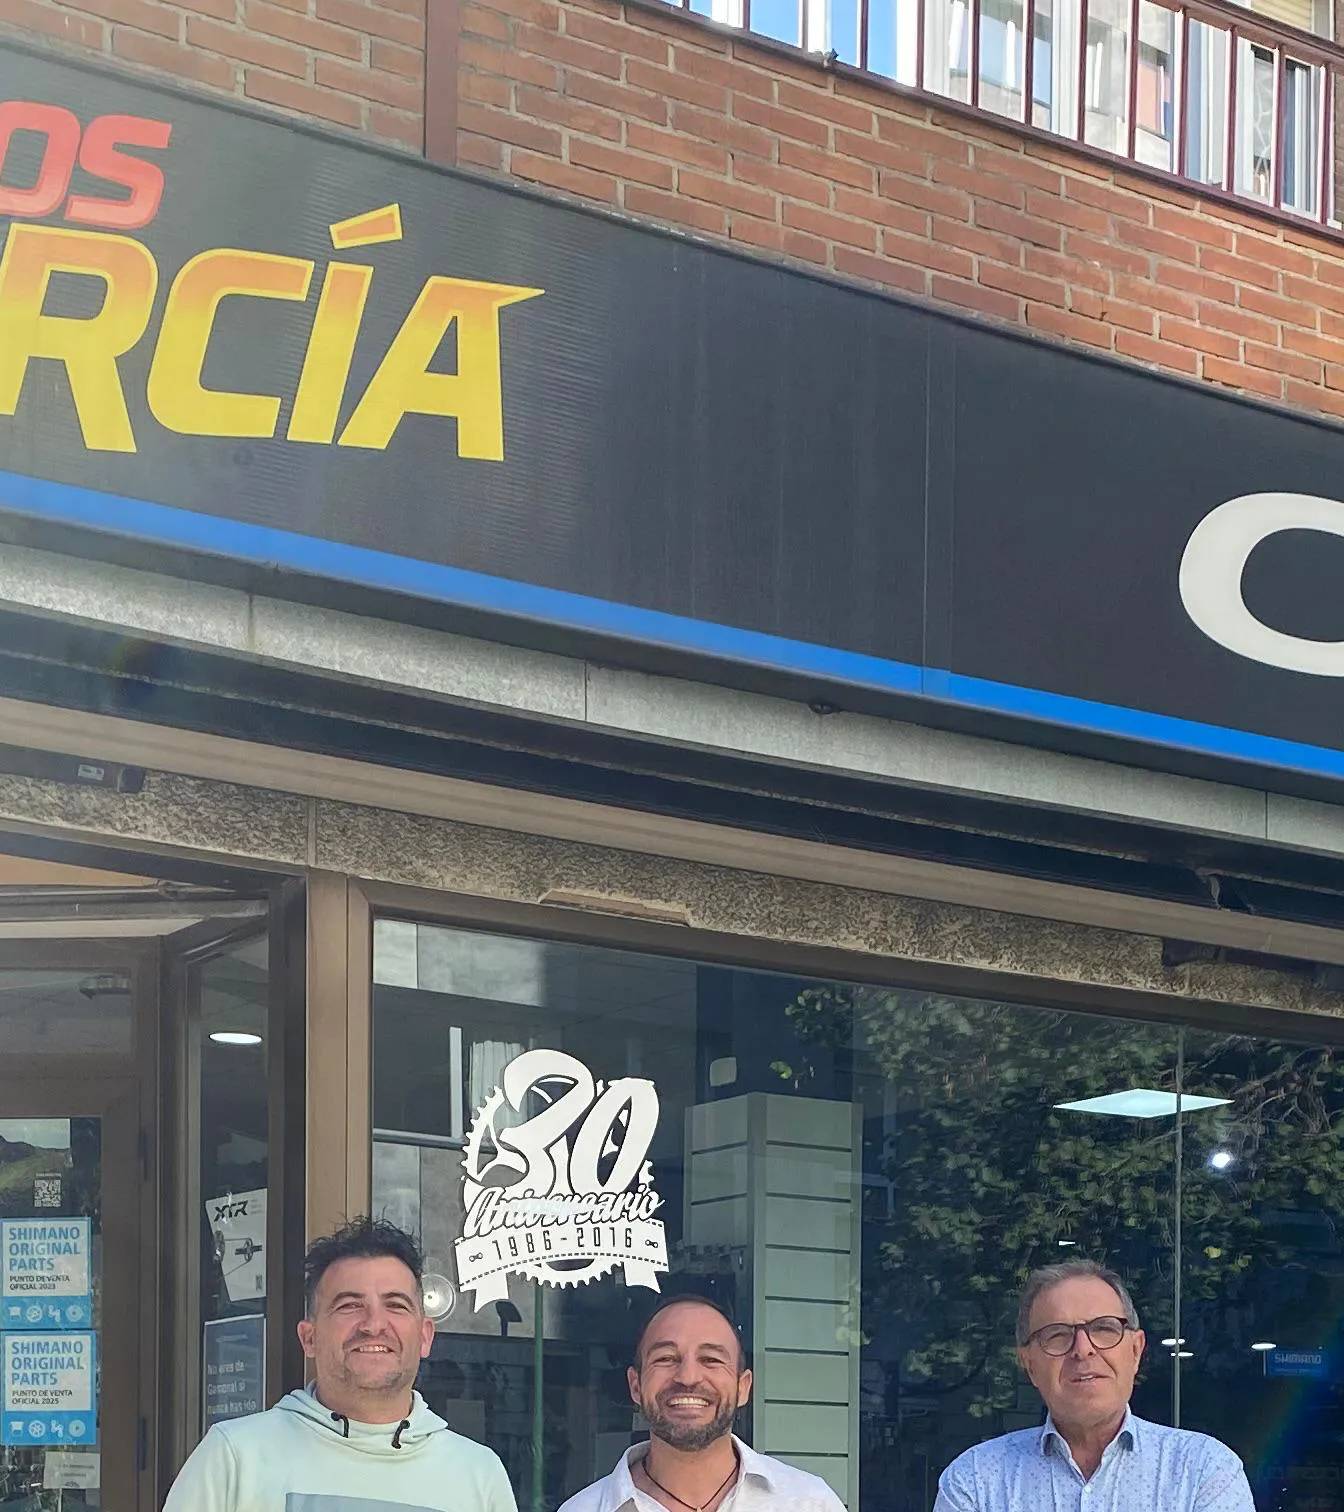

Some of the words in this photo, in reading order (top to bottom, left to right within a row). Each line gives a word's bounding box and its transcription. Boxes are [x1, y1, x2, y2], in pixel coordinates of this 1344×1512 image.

[500, 1048, 660, 1195] 30
[214, 1200, 249, 1223] XTR
[9, 1227, 80, 1240] SHIMANO
[9, 1242, 81, 1256] ORIGINAL
[9, 1258, 55, 1272] PARTS
[9, 1275, 35, 1283] PUNTO
[11, 1341, 83, 1355] SHIMANO
[11, 1357, 84, 1370] ORIGINAL
[1275, 1353, 1321, 1364] SHIMANO
[11, 1372, 58, 1386] PARTS
